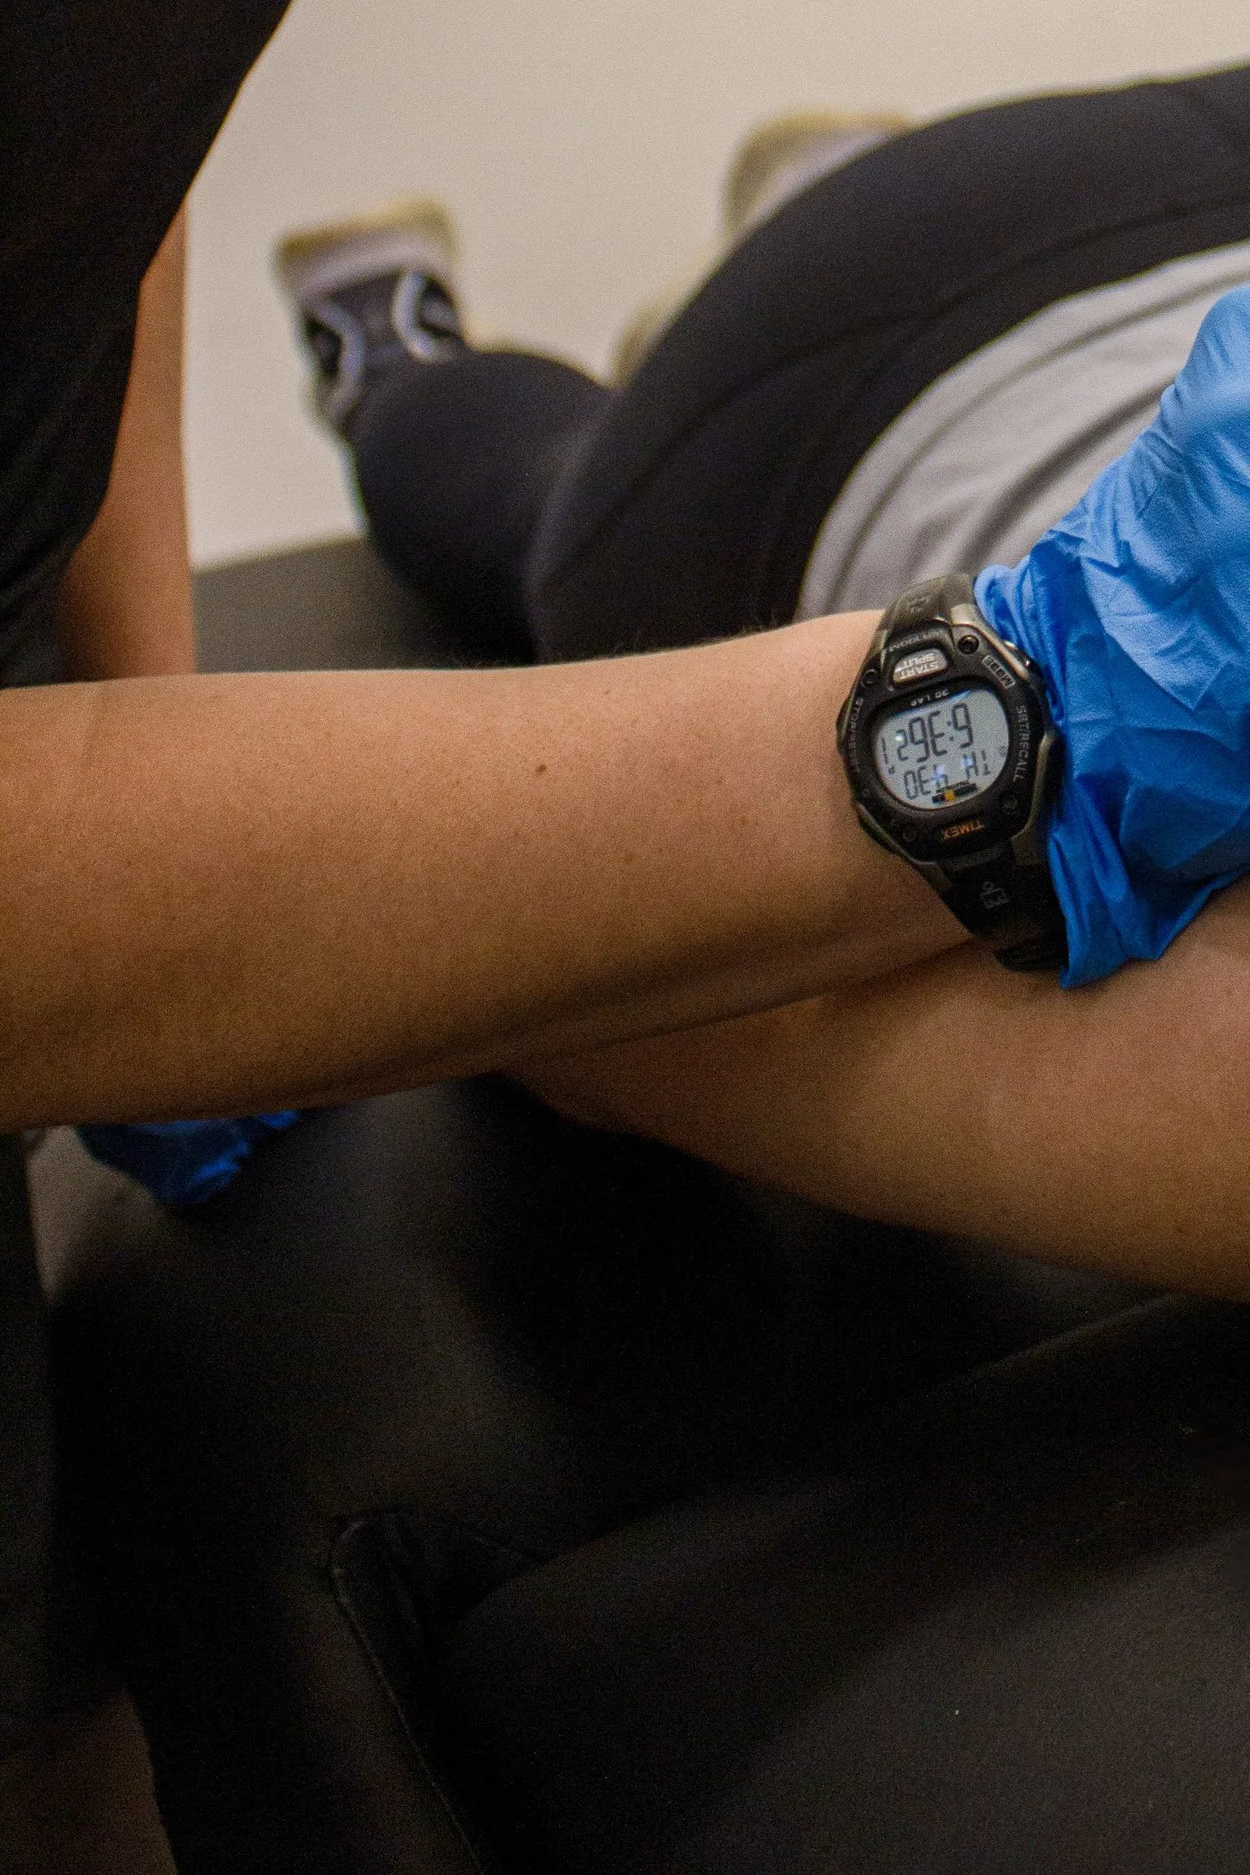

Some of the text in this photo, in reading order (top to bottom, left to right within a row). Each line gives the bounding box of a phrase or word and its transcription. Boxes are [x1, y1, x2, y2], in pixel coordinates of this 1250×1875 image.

[898, 660, 938, 680] START
[902, 652, 935, 670] SPLIT
[910, 692, 931, 706] LAP
[941, 819, 985, 841] TIMEX
